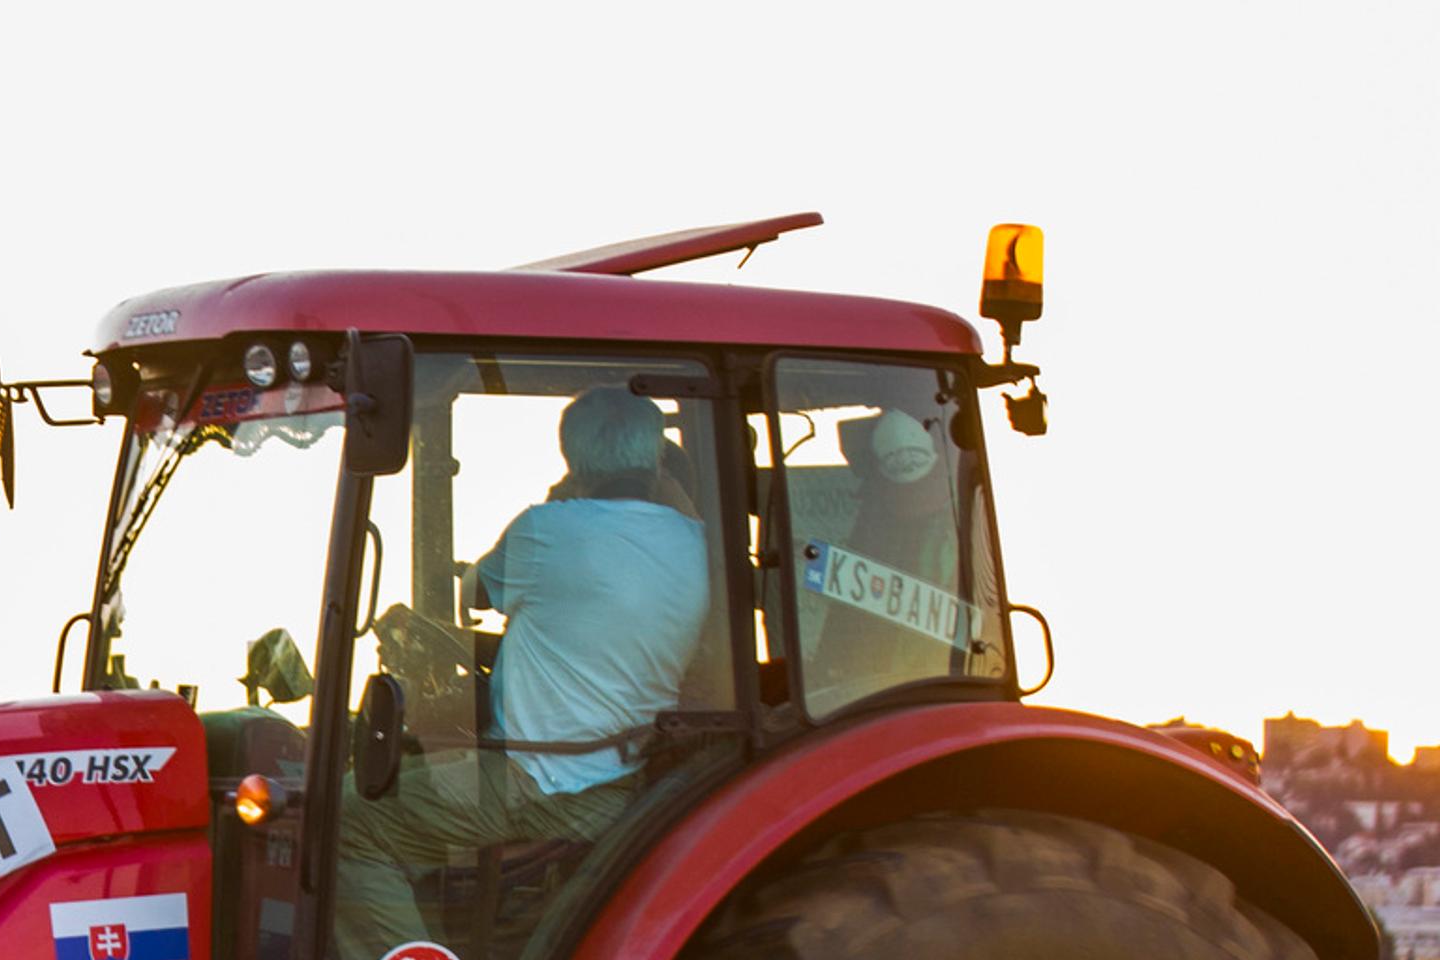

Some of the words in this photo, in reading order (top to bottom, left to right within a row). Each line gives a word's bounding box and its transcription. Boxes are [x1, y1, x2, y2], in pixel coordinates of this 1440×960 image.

[124, 311, 180, 338] ZETOR
[828, 551, 868, 602] KS
[86, 754, 152, 782] HSX
